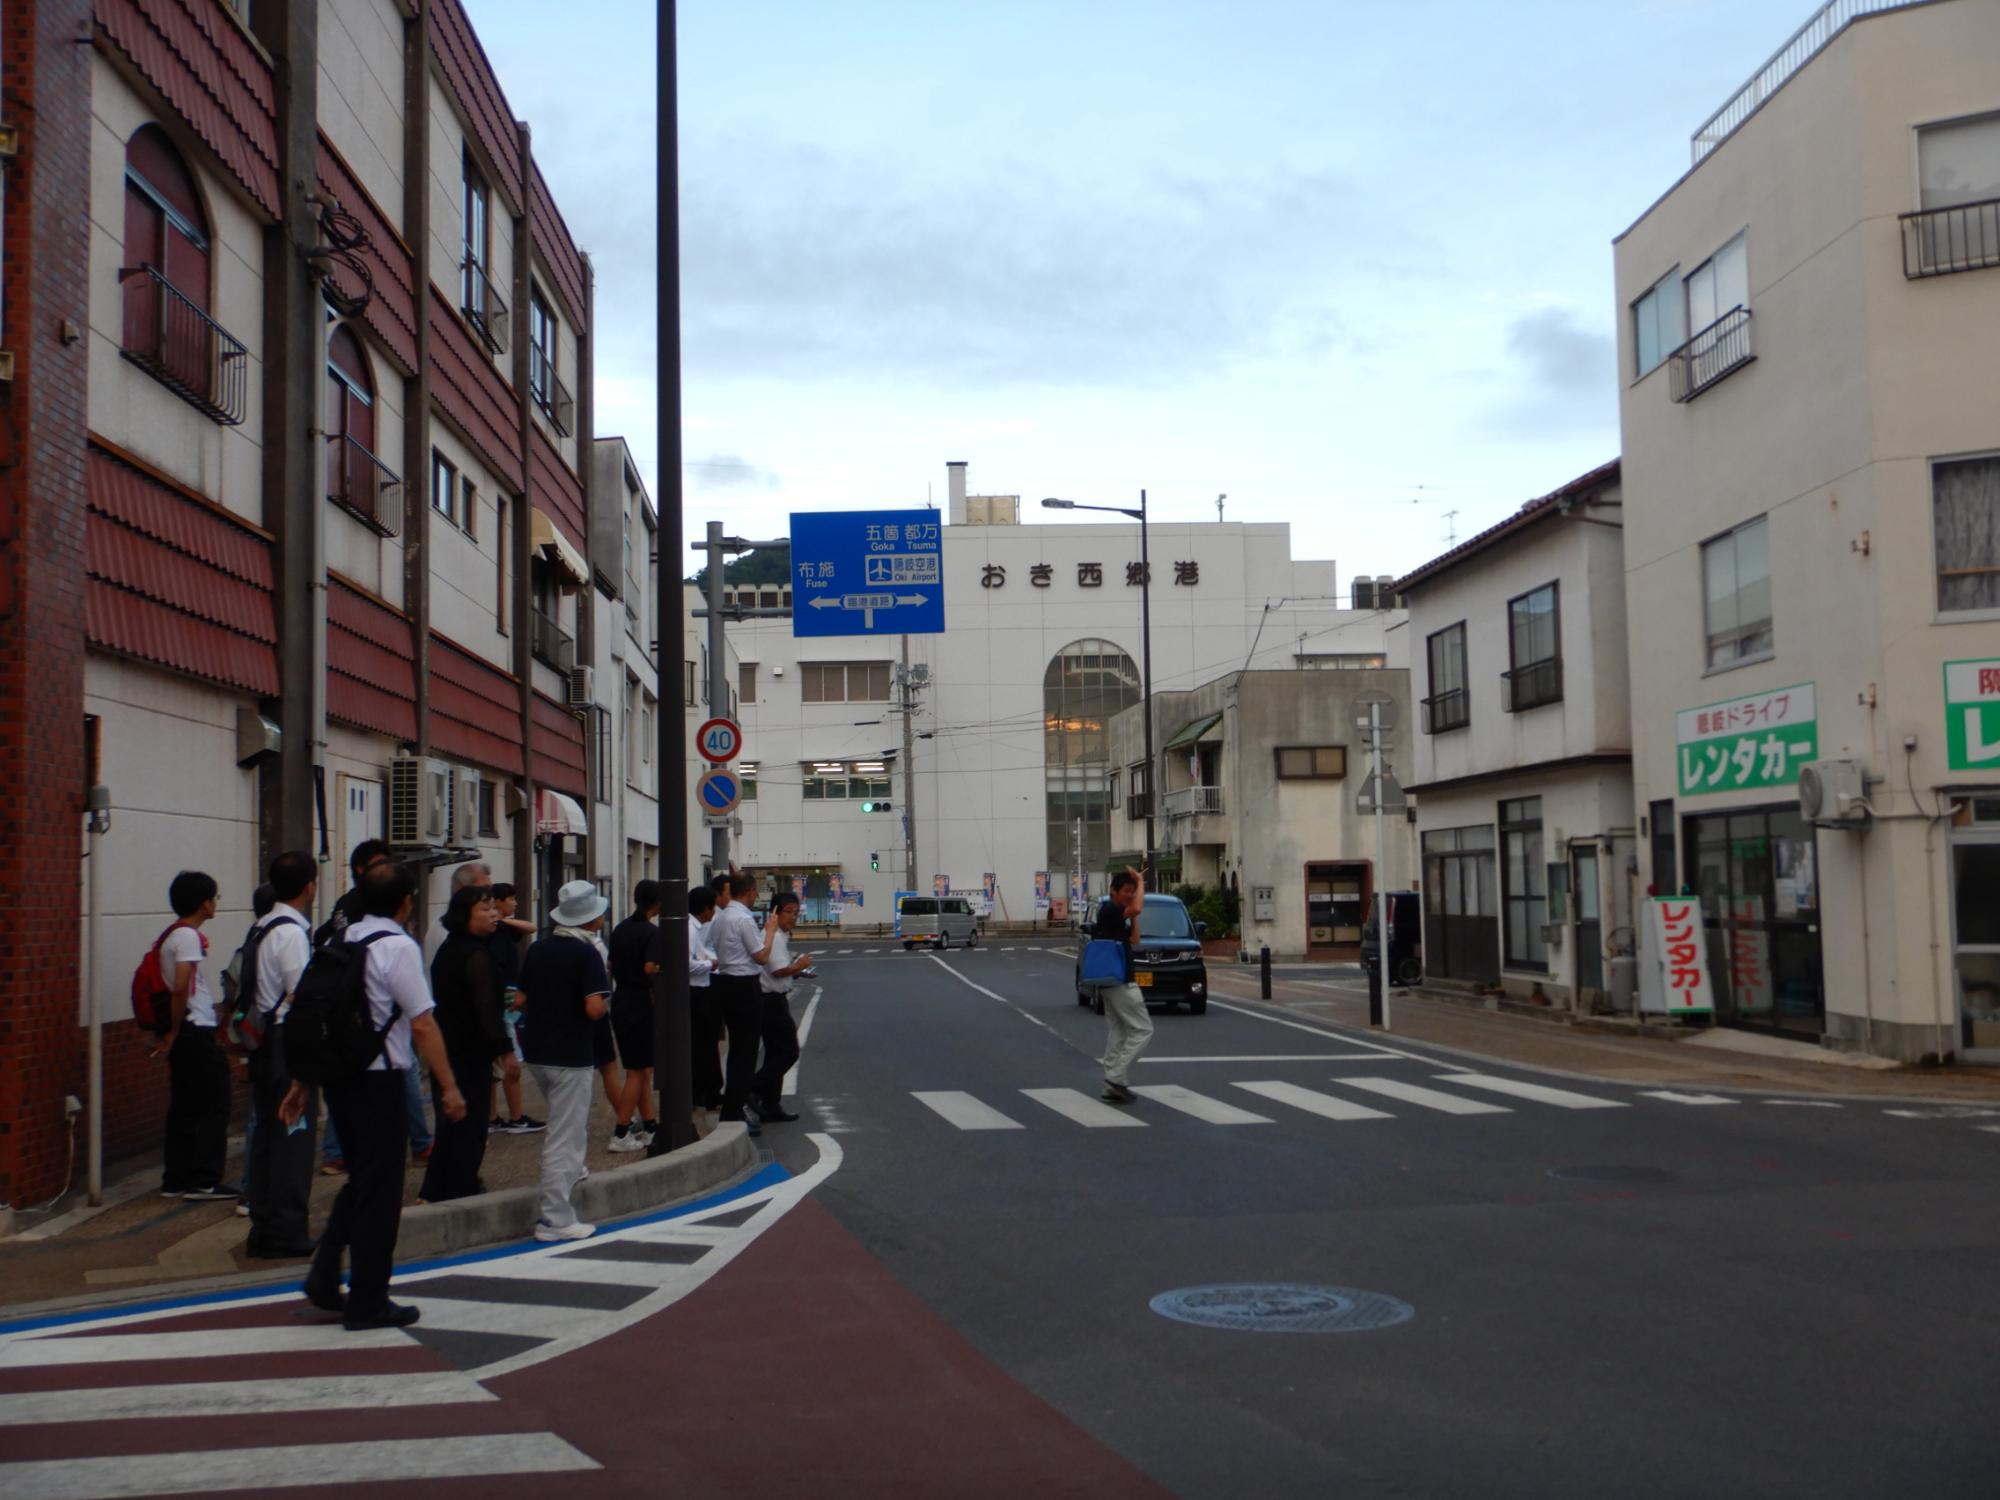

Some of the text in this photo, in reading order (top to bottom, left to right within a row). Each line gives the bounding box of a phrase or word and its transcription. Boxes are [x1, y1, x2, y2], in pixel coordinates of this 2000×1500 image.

[866, 523, 938, 541] 五箇 都万
[871, 541, 937, 551] Goka Tsuma
[798, 561, 835, 578] 布施
[912, 573, 937, 583] Airport
[806, 580, 828, 588] Fuse
[707, 731, 732, 750] 40
[1682, 733, 1812, 790] レンタカー
[1662, 902, 1701, 1007] レンタカー
